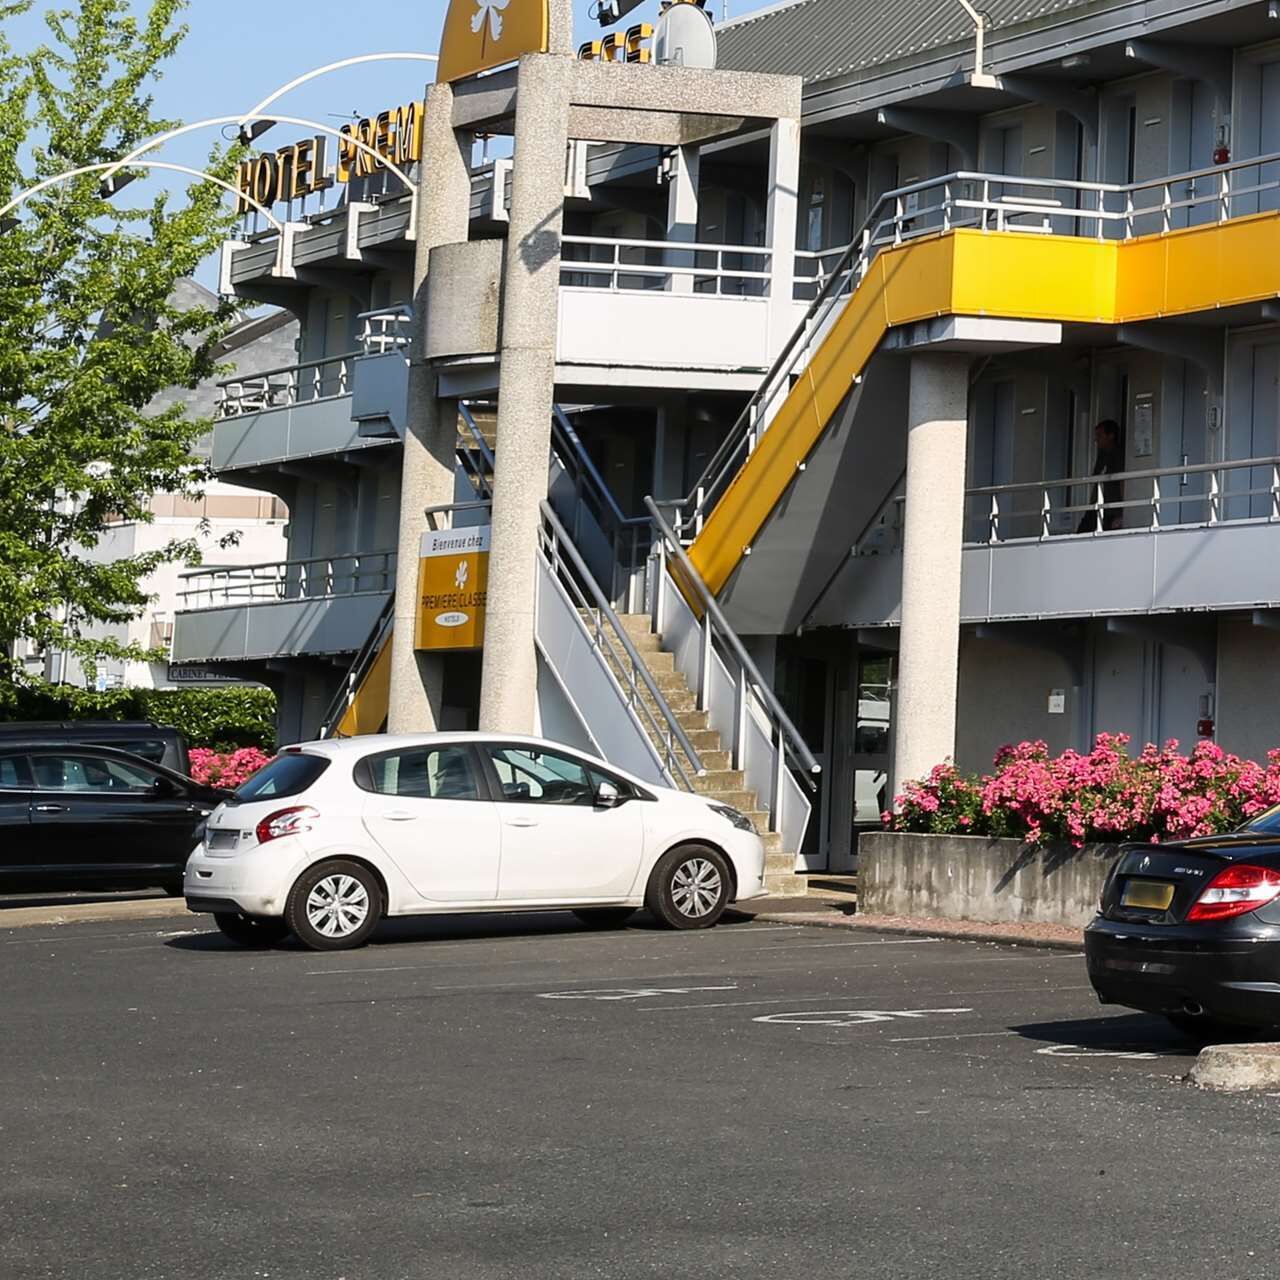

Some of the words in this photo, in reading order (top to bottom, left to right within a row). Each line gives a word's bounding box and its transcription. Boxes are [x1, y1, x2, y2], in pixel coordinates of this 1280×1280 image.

[237, 135, 334, 214] HOTEL
[432, 538, 466, 551] Bienvenue
[468, 535, 483, 547] chez
